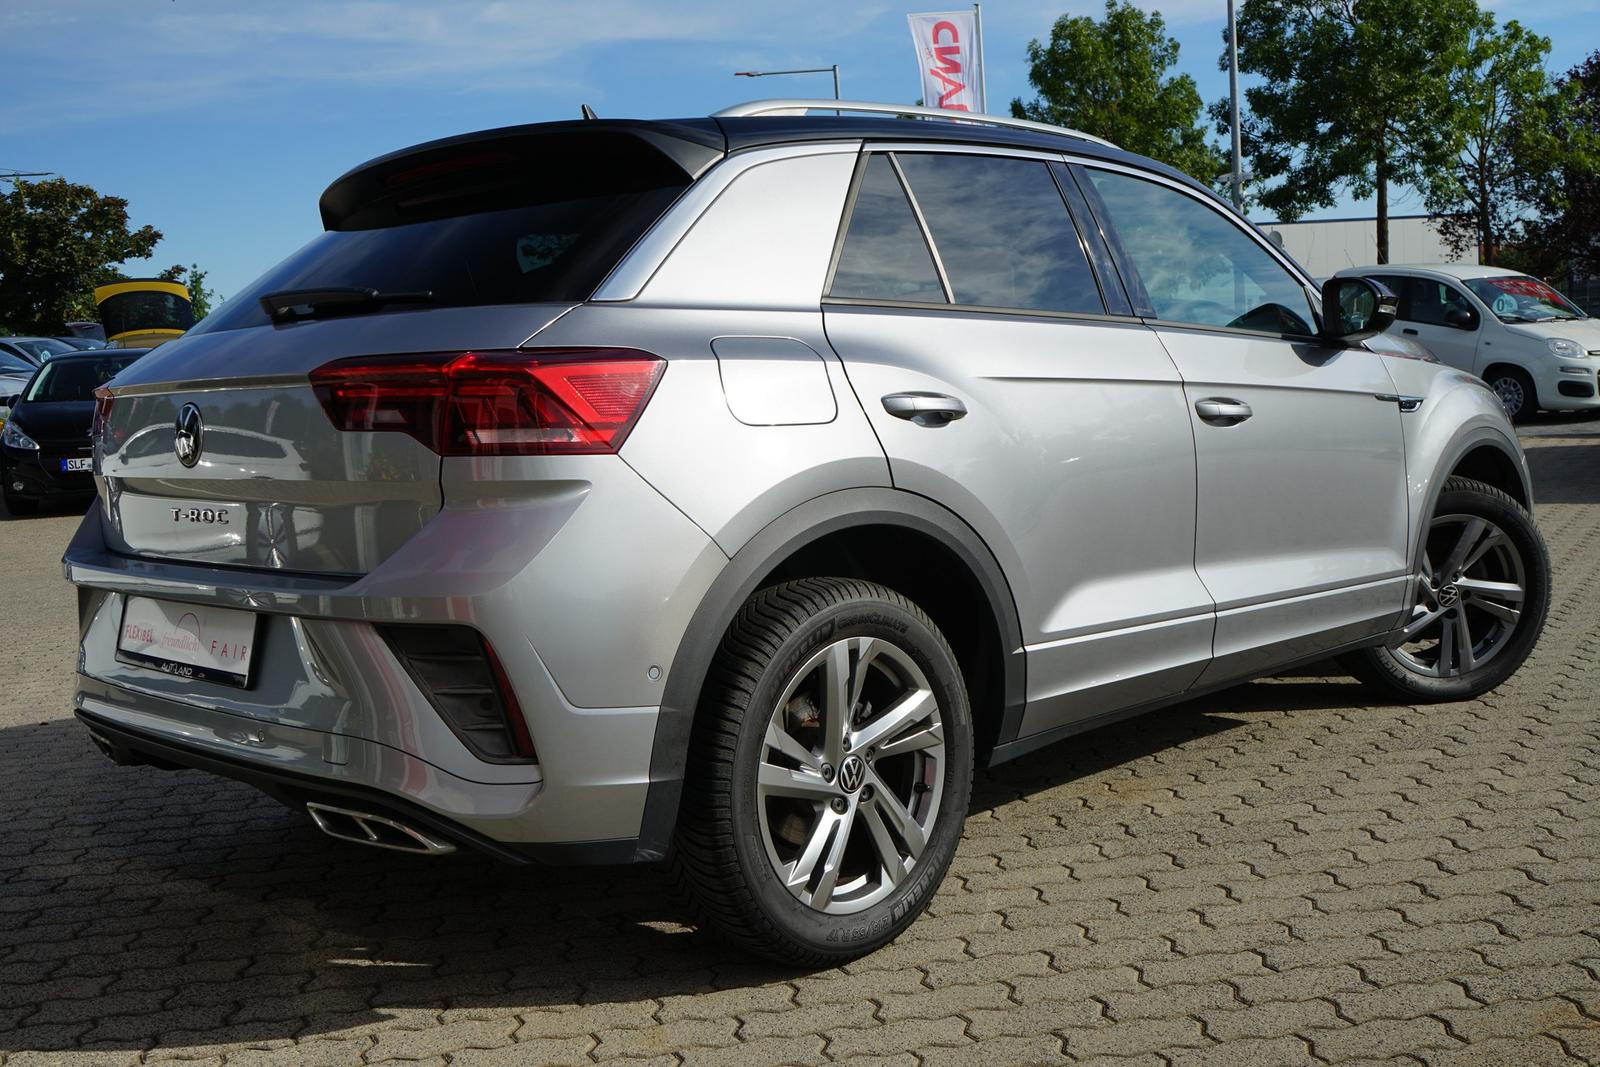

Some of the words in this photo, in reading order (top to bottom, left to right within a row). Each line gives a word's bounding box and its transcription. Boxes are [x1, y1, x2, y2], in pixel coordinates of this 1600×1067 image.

[68, 459, 86, 470] SLF
[168, 507, 230, 525] T-ROC
[124, 624, 154, 644] FLEXIBEL
[160, 631, 199, 651] freundlich
[209, 639, 248, 661] FAIR
